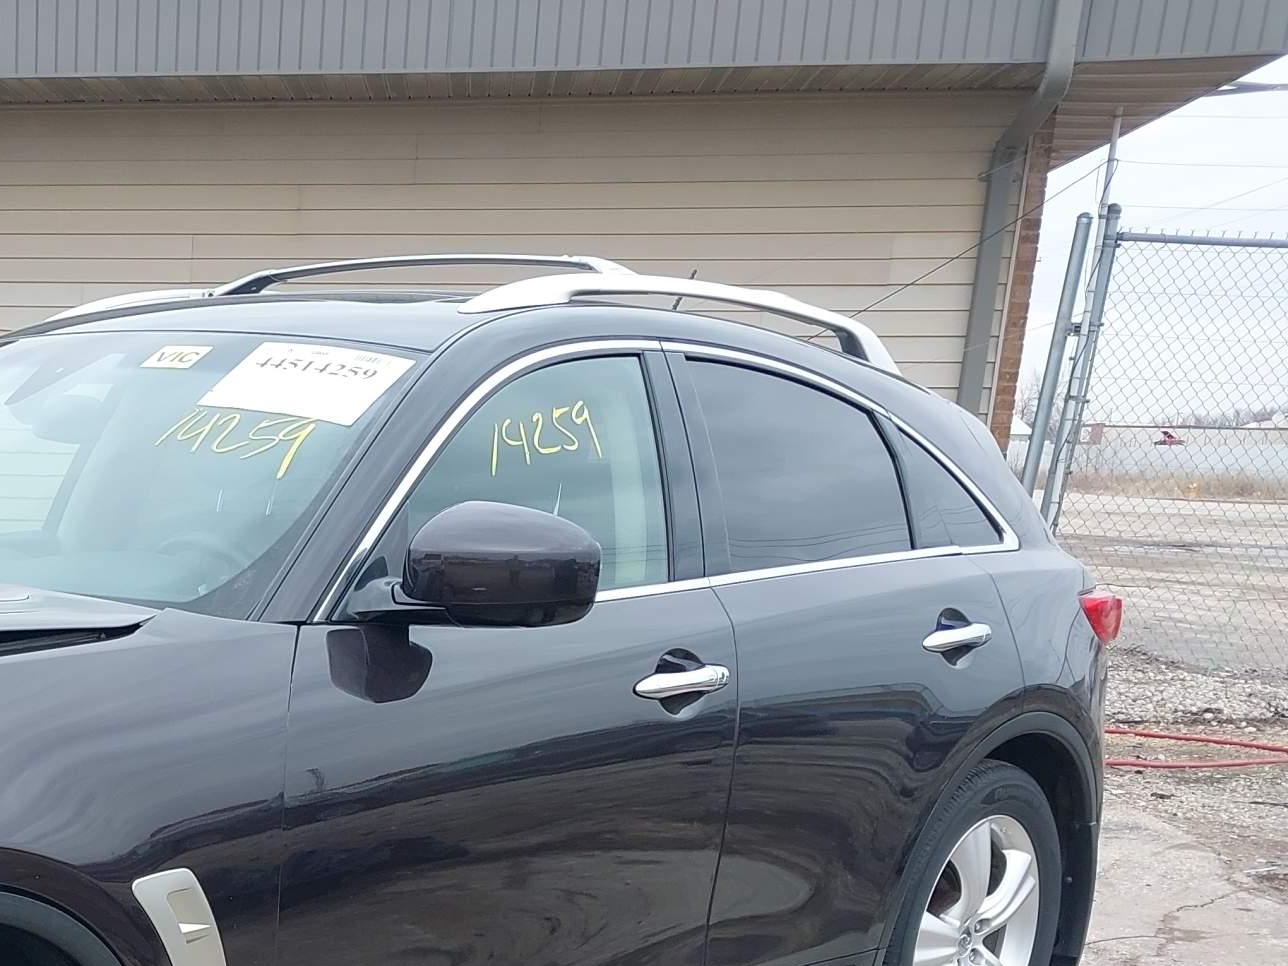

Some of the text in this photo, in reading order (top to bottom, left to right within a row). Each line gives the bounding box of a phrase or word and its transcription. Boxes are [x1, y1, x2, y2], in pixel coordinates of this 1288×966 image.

[156, 351, 200, 363] VIC
[255, 356, 378, 380] 44514259
[154, 408, 318, 480] 14259
[490, 400, 603, 477] 14259
